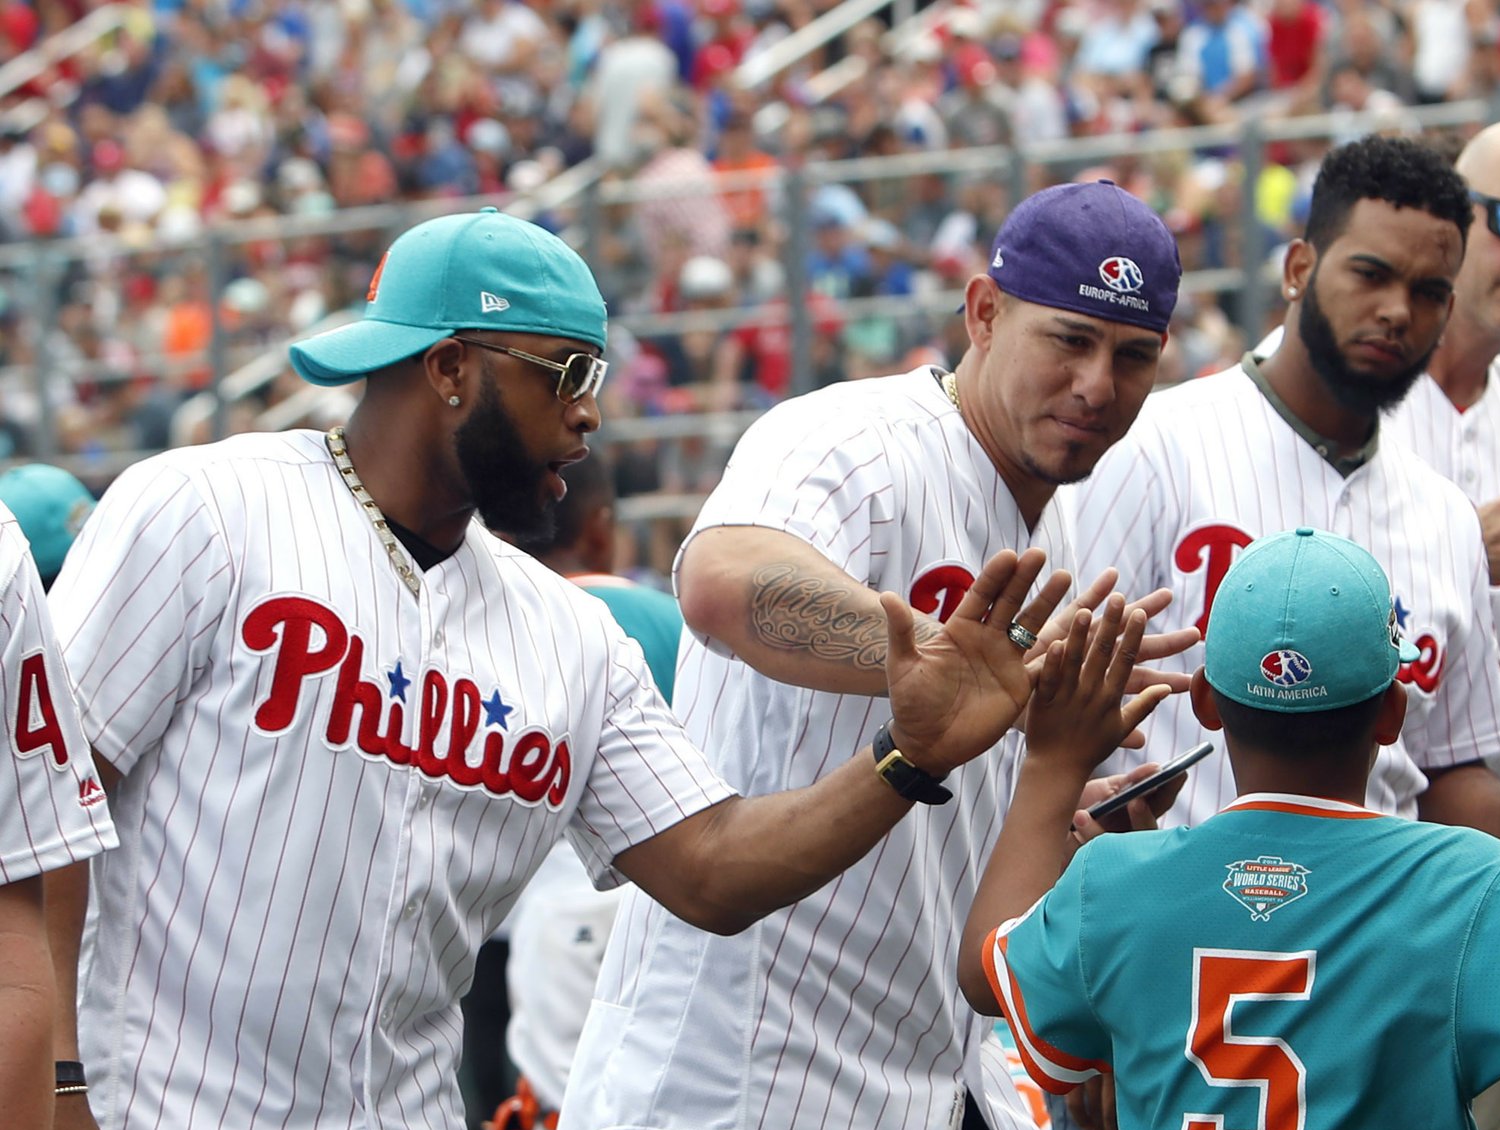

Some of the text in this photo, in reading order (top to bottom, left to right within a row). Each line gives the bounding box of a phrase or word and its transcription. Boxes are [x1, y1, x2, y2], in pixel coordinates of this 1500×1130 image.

[1079, 284, 1149, 312] EUROPE-AFRICA
[241, 596, 573, 809] Phillies
[1247, 683, 1328, 701] LATIN AMERICA
[13, 652, 69, 766] 4
[1233, 873, 1300, 891] WORLD SERIES
[1244, 888, 1284, 896] BASEBALL
